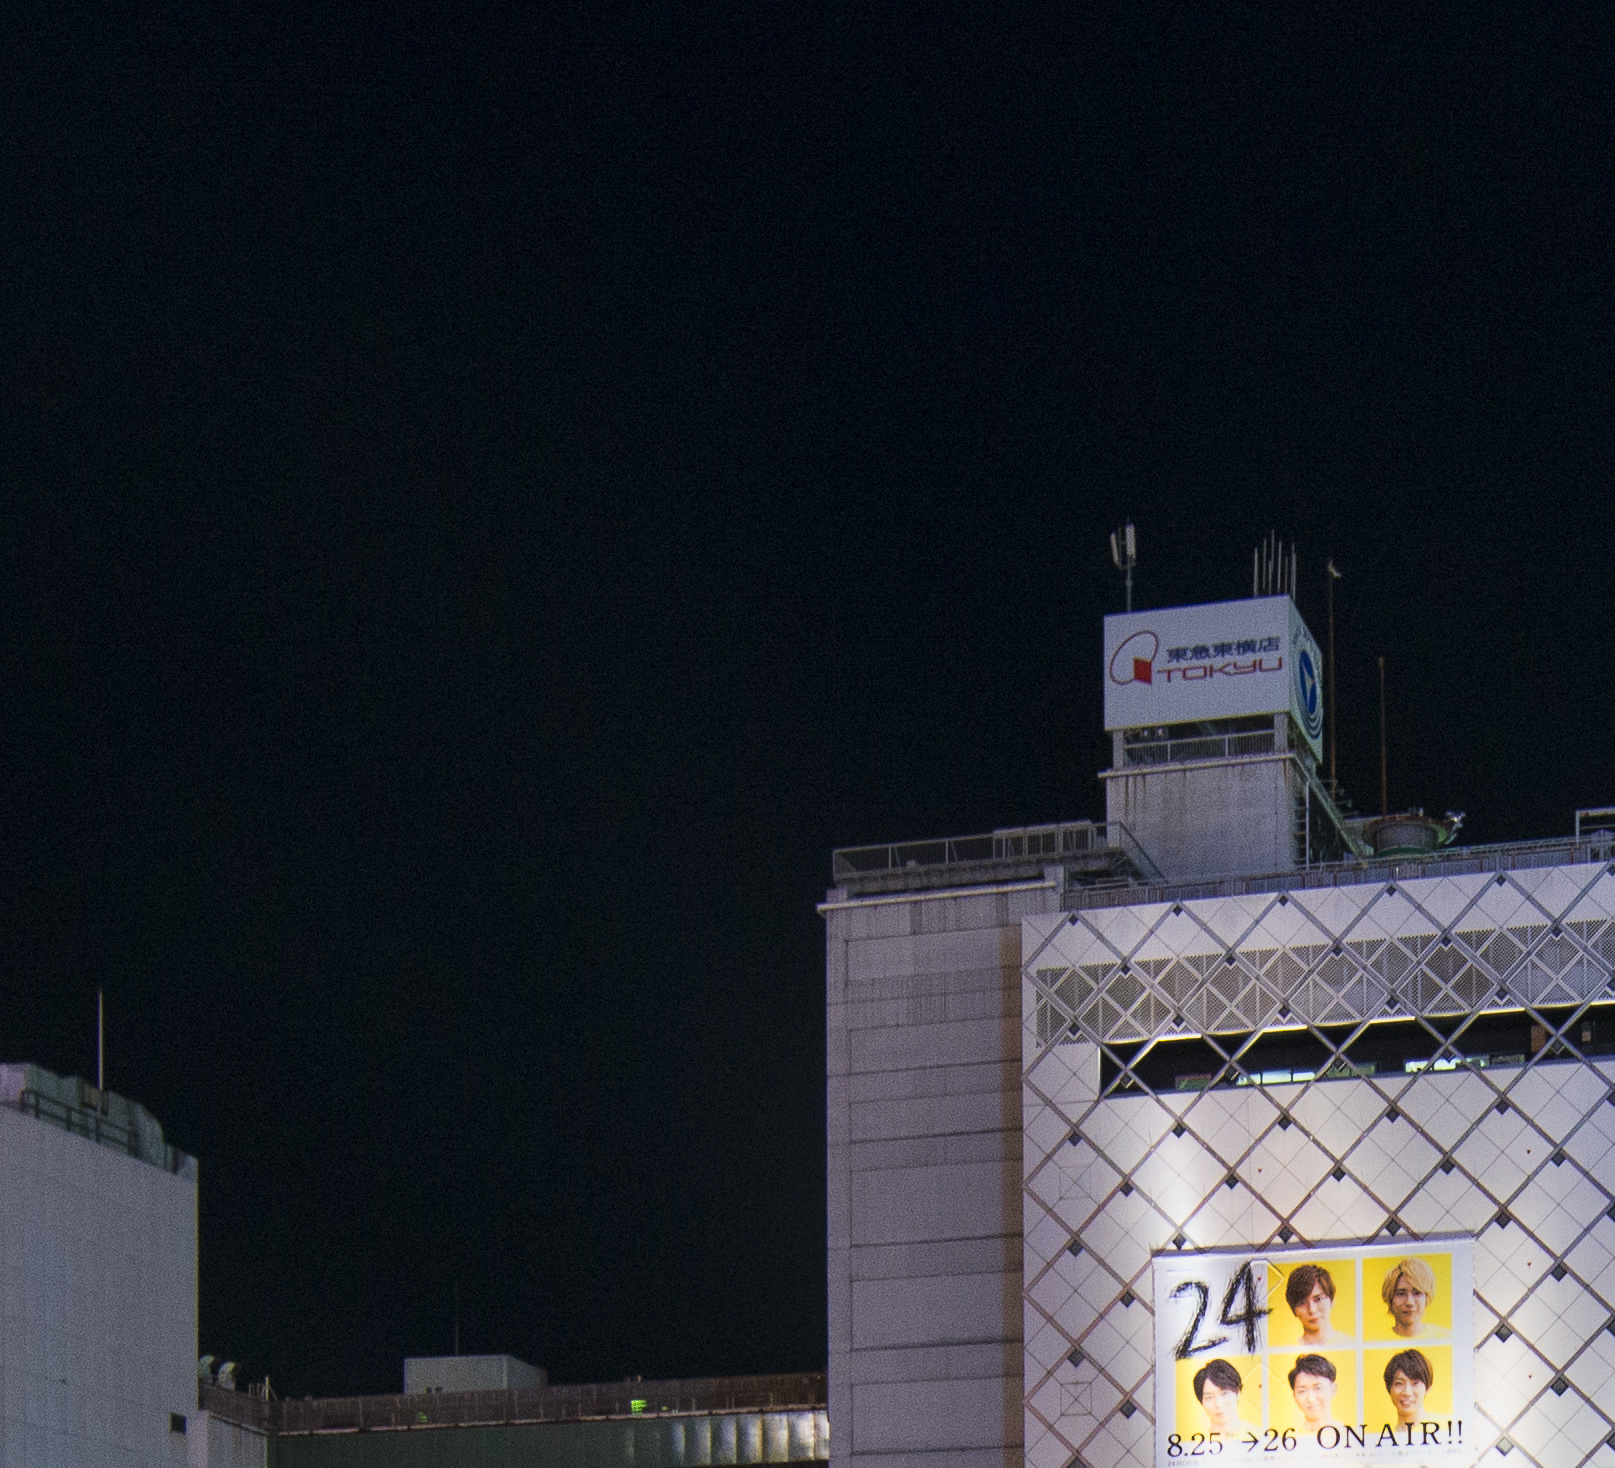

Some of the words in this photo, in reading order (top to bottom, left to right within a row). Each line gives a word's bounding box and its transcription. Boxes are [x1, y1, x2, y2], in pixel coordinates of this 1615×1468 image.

[1167, 636, 1281, 663] 東急東横店
[1156, 656, 1283, 683] TOKYU
[1168, 1257, 1274, 1362] 24
[1166, 1431, 1224, 1458] 8.25
[1316, 1420, 1368, 1450] ON
[1375, 1420, 1464, 1448] AIR!!
